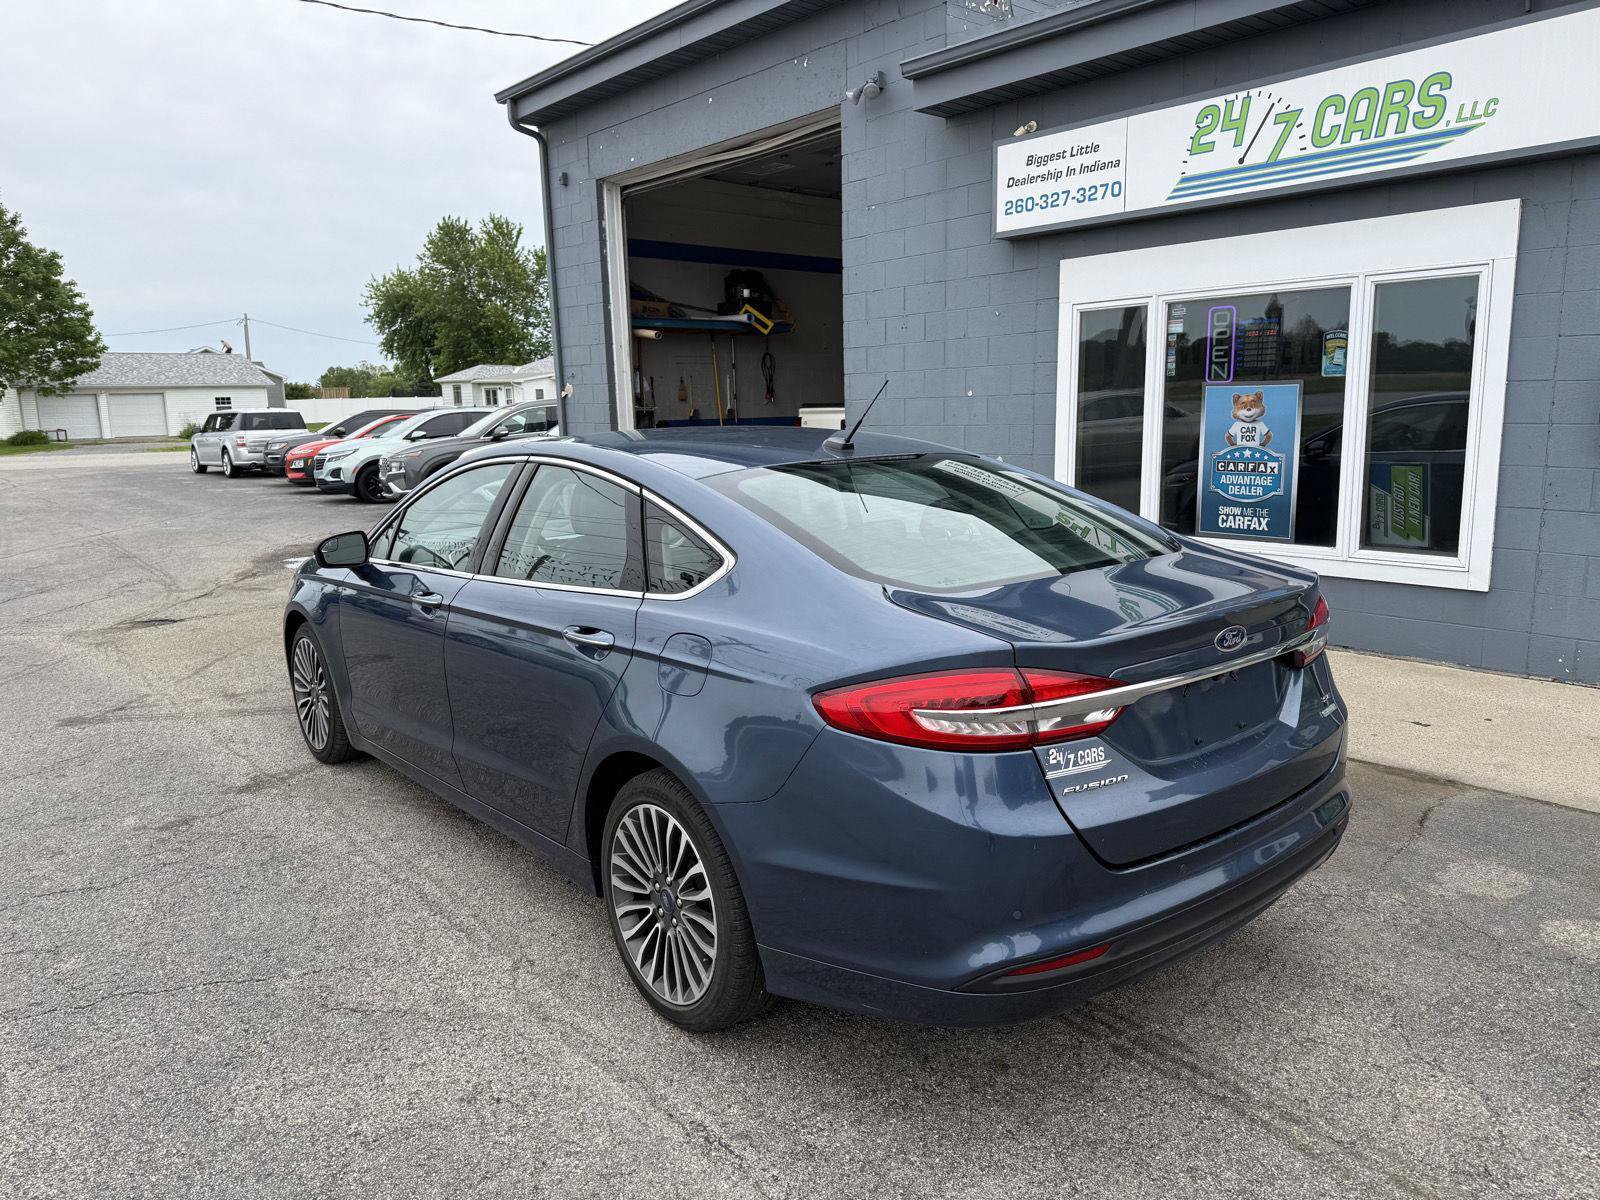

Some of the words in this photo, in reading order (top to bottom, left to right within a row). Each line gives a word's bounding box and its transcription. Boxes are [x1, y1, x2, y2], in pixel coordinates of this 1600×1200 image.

[1454, 97, 1500, 124] LLC
[1025, 149, 1067, 167] Biggest
[1069, 142, 1100, 158] Little
[1006, 168, 1063, 188] Dealership
[1065, 166, 1076, 177] In
[1079, 159, 1121, 175] Indiana
[1004, 180, 1122, 216] 260-327-3270
[1211, 311, 1230, 379] OPEN
[1240, 426, 1257, 434] CAR
[1240, 434, 1256, 443] FOX
[1217, 461, 1278, 474] CARFAX
[1220, 474, 1273, 486] ADVANTAGE
[1228, 485, 1263, 496] DEALER
[1408, 471, 1421, 496] CAR!
[1393, 481, 1405, 502] GOT
[1218, 505, 1241, 515] SHOW
[1242, 507, 1255, 517] ME
[1255, 507, 1270, 517] THE
[1393, 500, 1405, 525] JUST
[1409, 495, 1421, 519] NEW
[1218, 515, 1269, 531] CARFAX
[1077, 746, 1105, 765] CARS
[1062, 774, 1128, 796] FUSION
